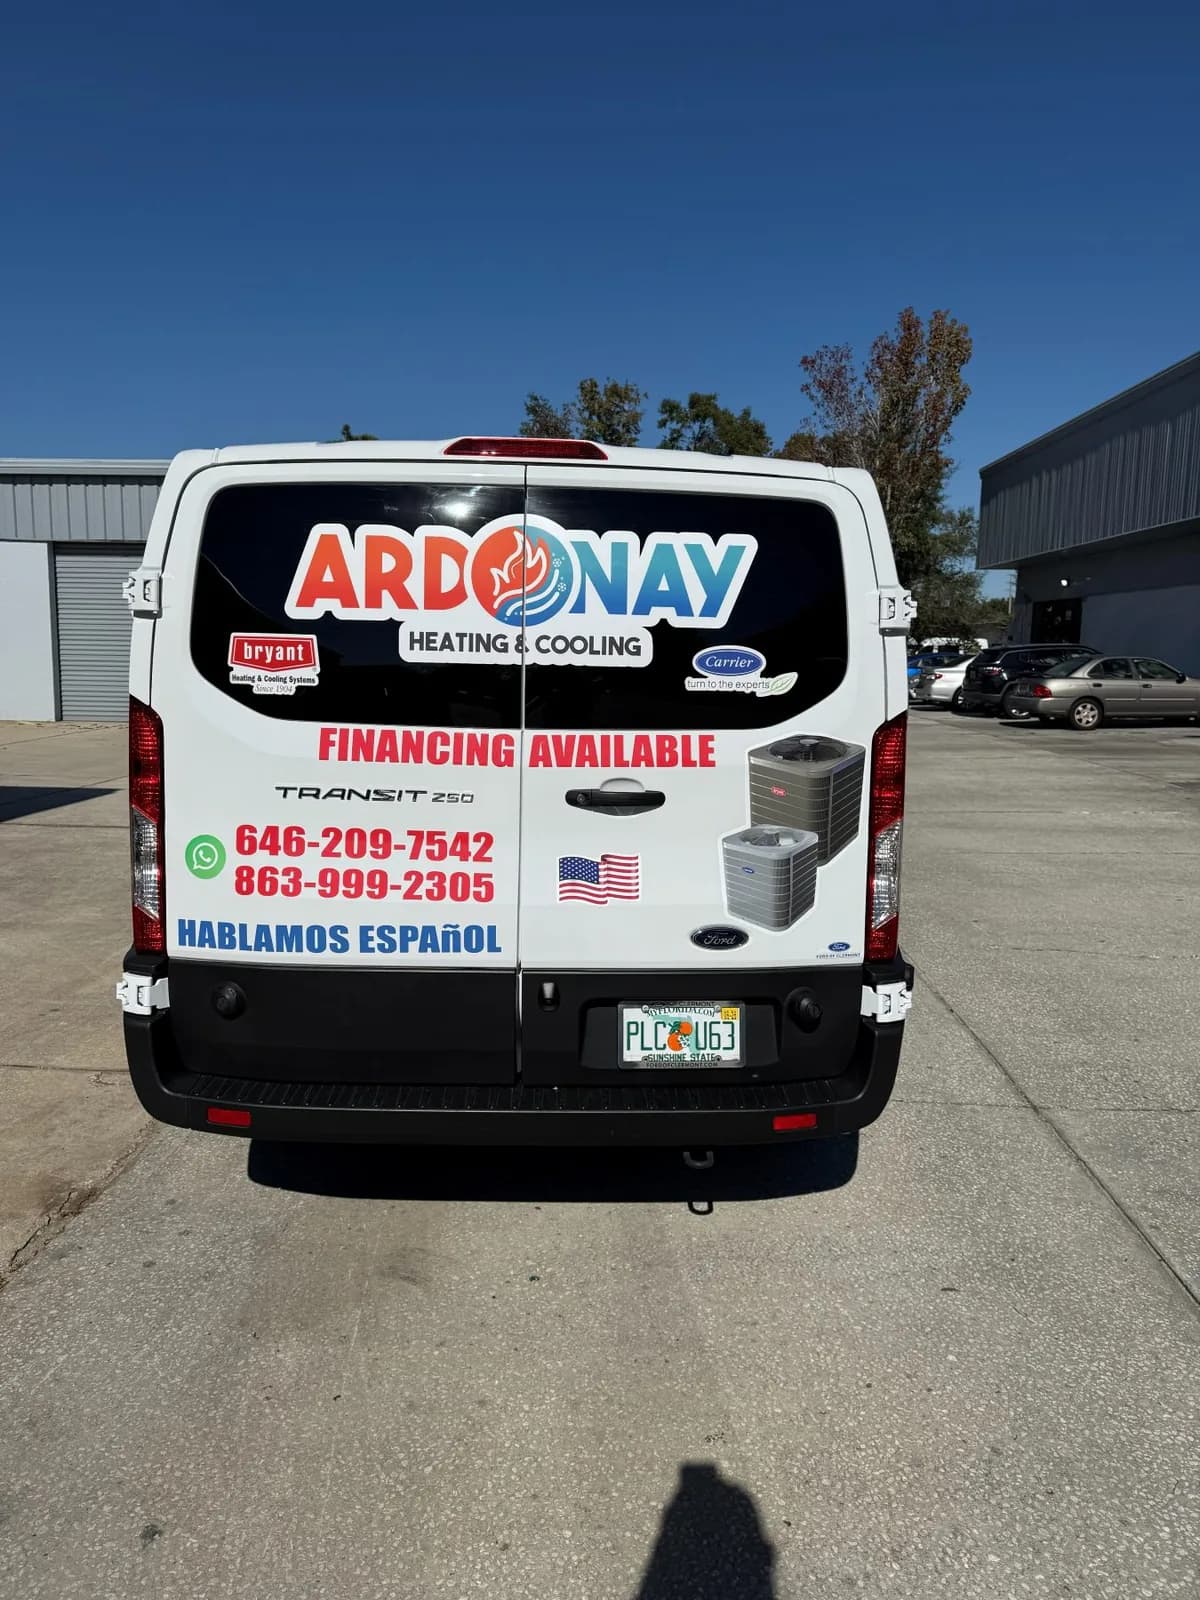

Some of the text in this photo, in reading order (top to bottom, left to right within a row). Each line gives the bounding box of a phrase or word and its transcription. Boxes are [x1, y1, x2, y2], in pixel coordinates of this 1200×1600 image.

[295, 525, 747, 627] ARDONAY
[243, 641, 305, 664] bryant
[409, 631, 643, 657] HEATING & COOLING
[705, 655, 755, 669] Carrier
[231, 674, 256, 684] Heating
[264, 675, 288, 685] Cooling
[289, 676, 316, 684] Systems
[255, 684, 294, 694] Since 1904
[687, 680, 770, 691] turn to the experts
[318, 727, 717, 768] FINANCING AVAILABLE
[274, 785, 475, 804] TRANSIT 250
[235, 824, 495, 863] 646-209-7542
[234, 865, 495, 903] 863-999-2305
[177, 918, 350, 954] HABLAMOS
[703, 934, 737, 945] Ford
[626, 1021, 735, 1051] PLC U63
[647, 1053, 716, 1063] SUNSHINE STATE
